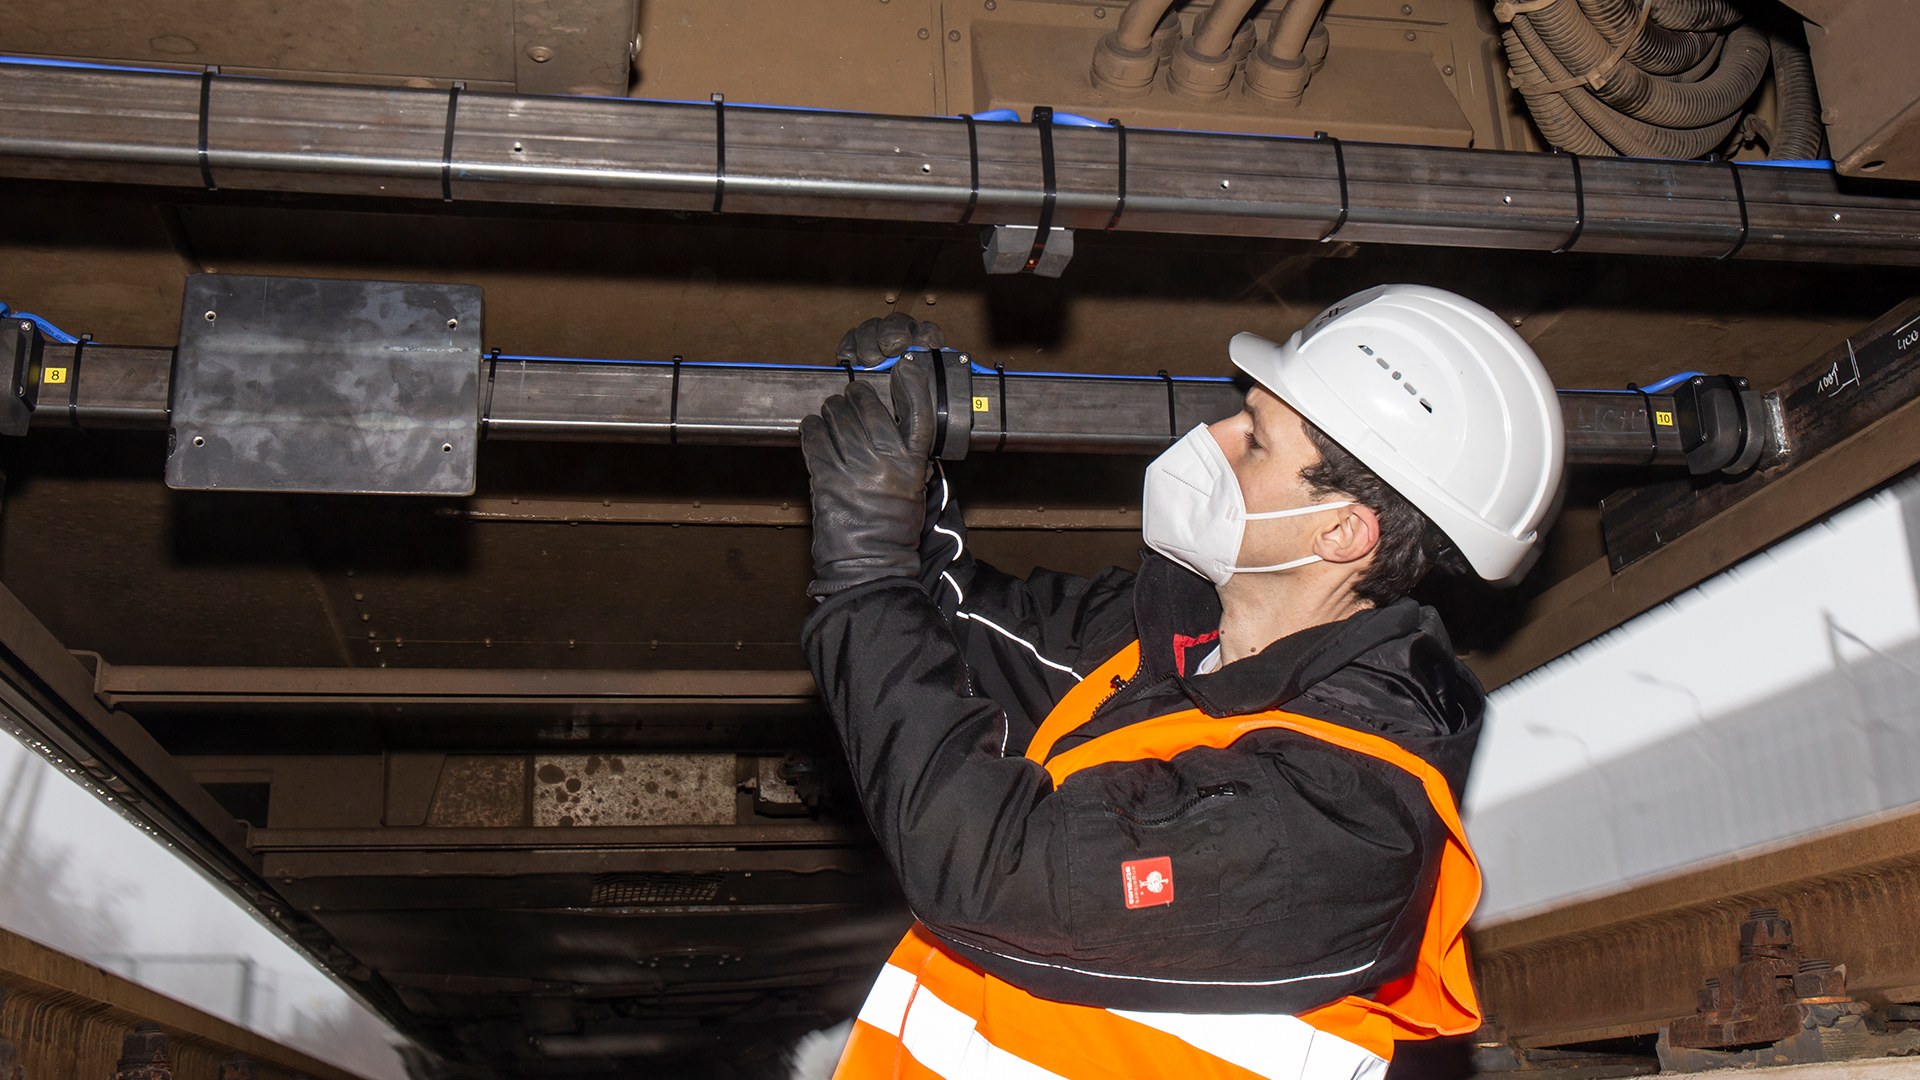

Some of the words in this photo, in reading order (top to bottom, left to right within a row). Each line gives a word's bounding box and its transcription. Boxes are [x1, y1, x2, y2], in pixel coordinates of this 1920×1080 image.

[51, 369, 60, 381] 8
[975, 399, 983, 410] 9
[1659, 413, 1671, 424] 10
[1125, 865, 1135, 905] strauss
